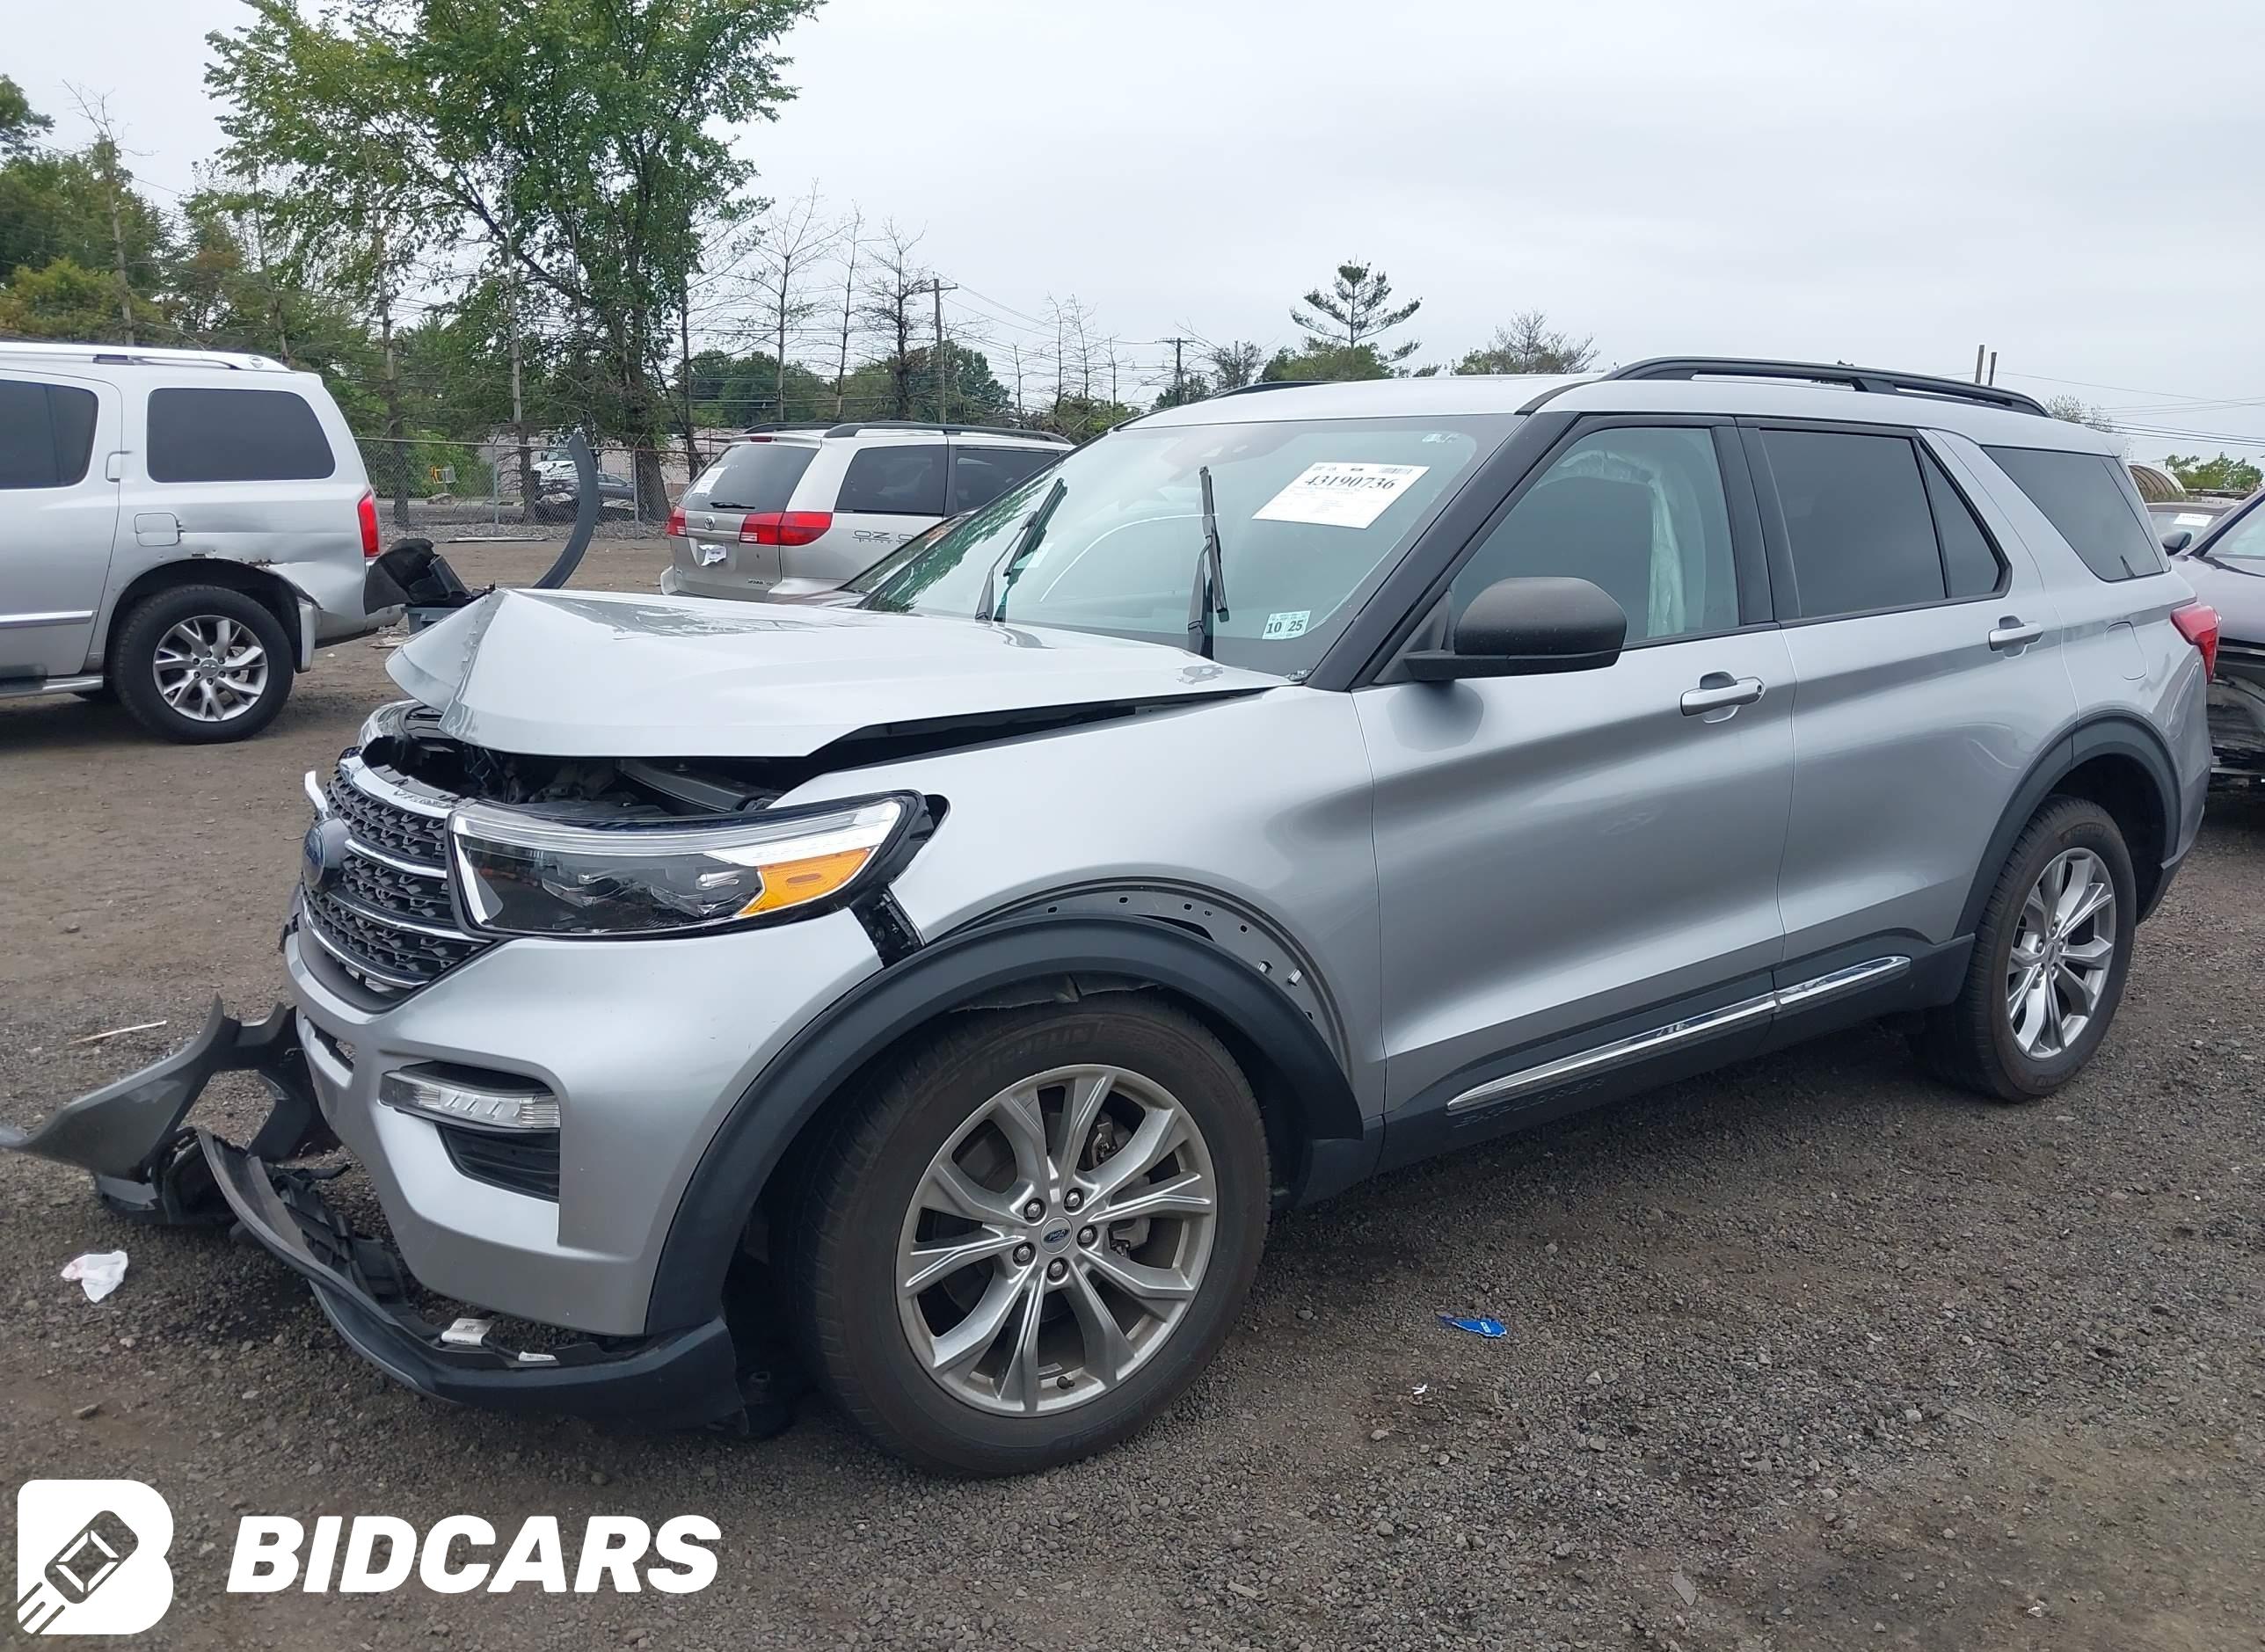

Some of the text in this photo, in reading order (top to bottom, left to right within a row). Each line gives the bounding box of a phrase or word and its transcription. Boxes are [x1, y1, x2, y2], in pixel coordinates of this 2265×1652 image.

[1304, 474, 1396, 490] 43190736
[1266, 619, 1304, 634] 10 25
